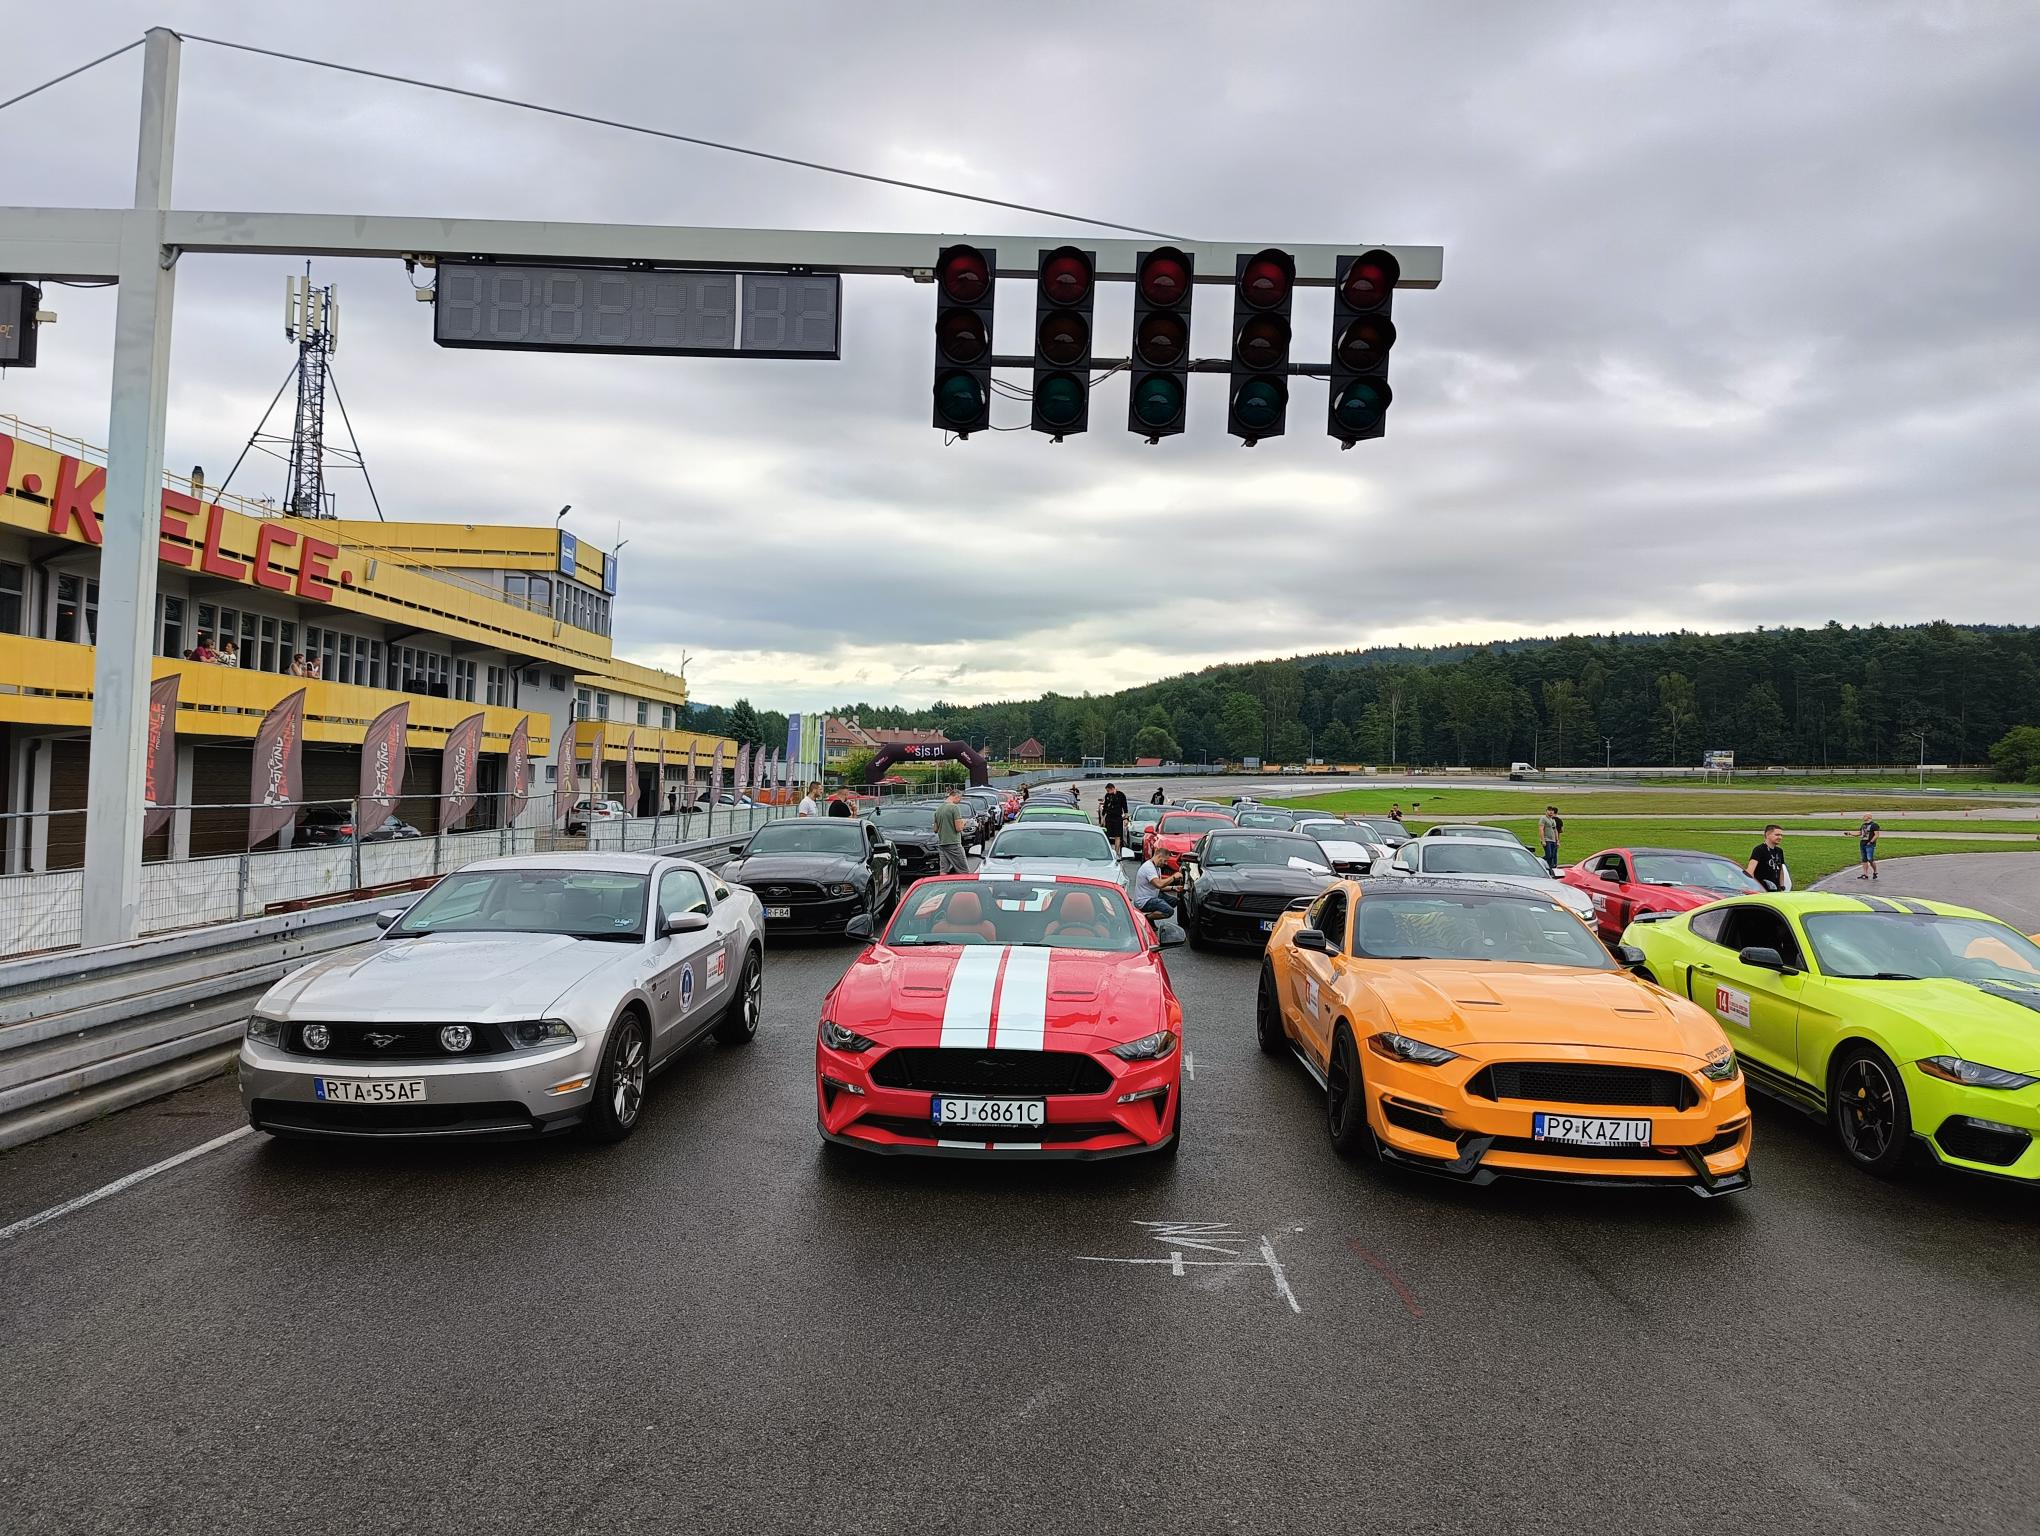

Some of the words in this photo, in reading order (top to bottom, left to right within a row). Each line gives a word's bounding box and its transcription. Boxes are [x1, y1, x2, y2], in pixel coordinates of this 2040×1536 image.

[49, 455, 339, 602] KELCE
[914, 745, 944, 757] sjs.pl
[1718, 990, 1729, 1012] 14
[326, 1081, 366, 1101] RTA
[372, 1081, 422, 1101] 55AF
[945, 1101, 969, 1121] SJ
[978, 1102, 1039, 1122] 6861C
[1547, 1117, 1574, 1137] P9
[1581, 1120, 1647, 1141] KAZIU
